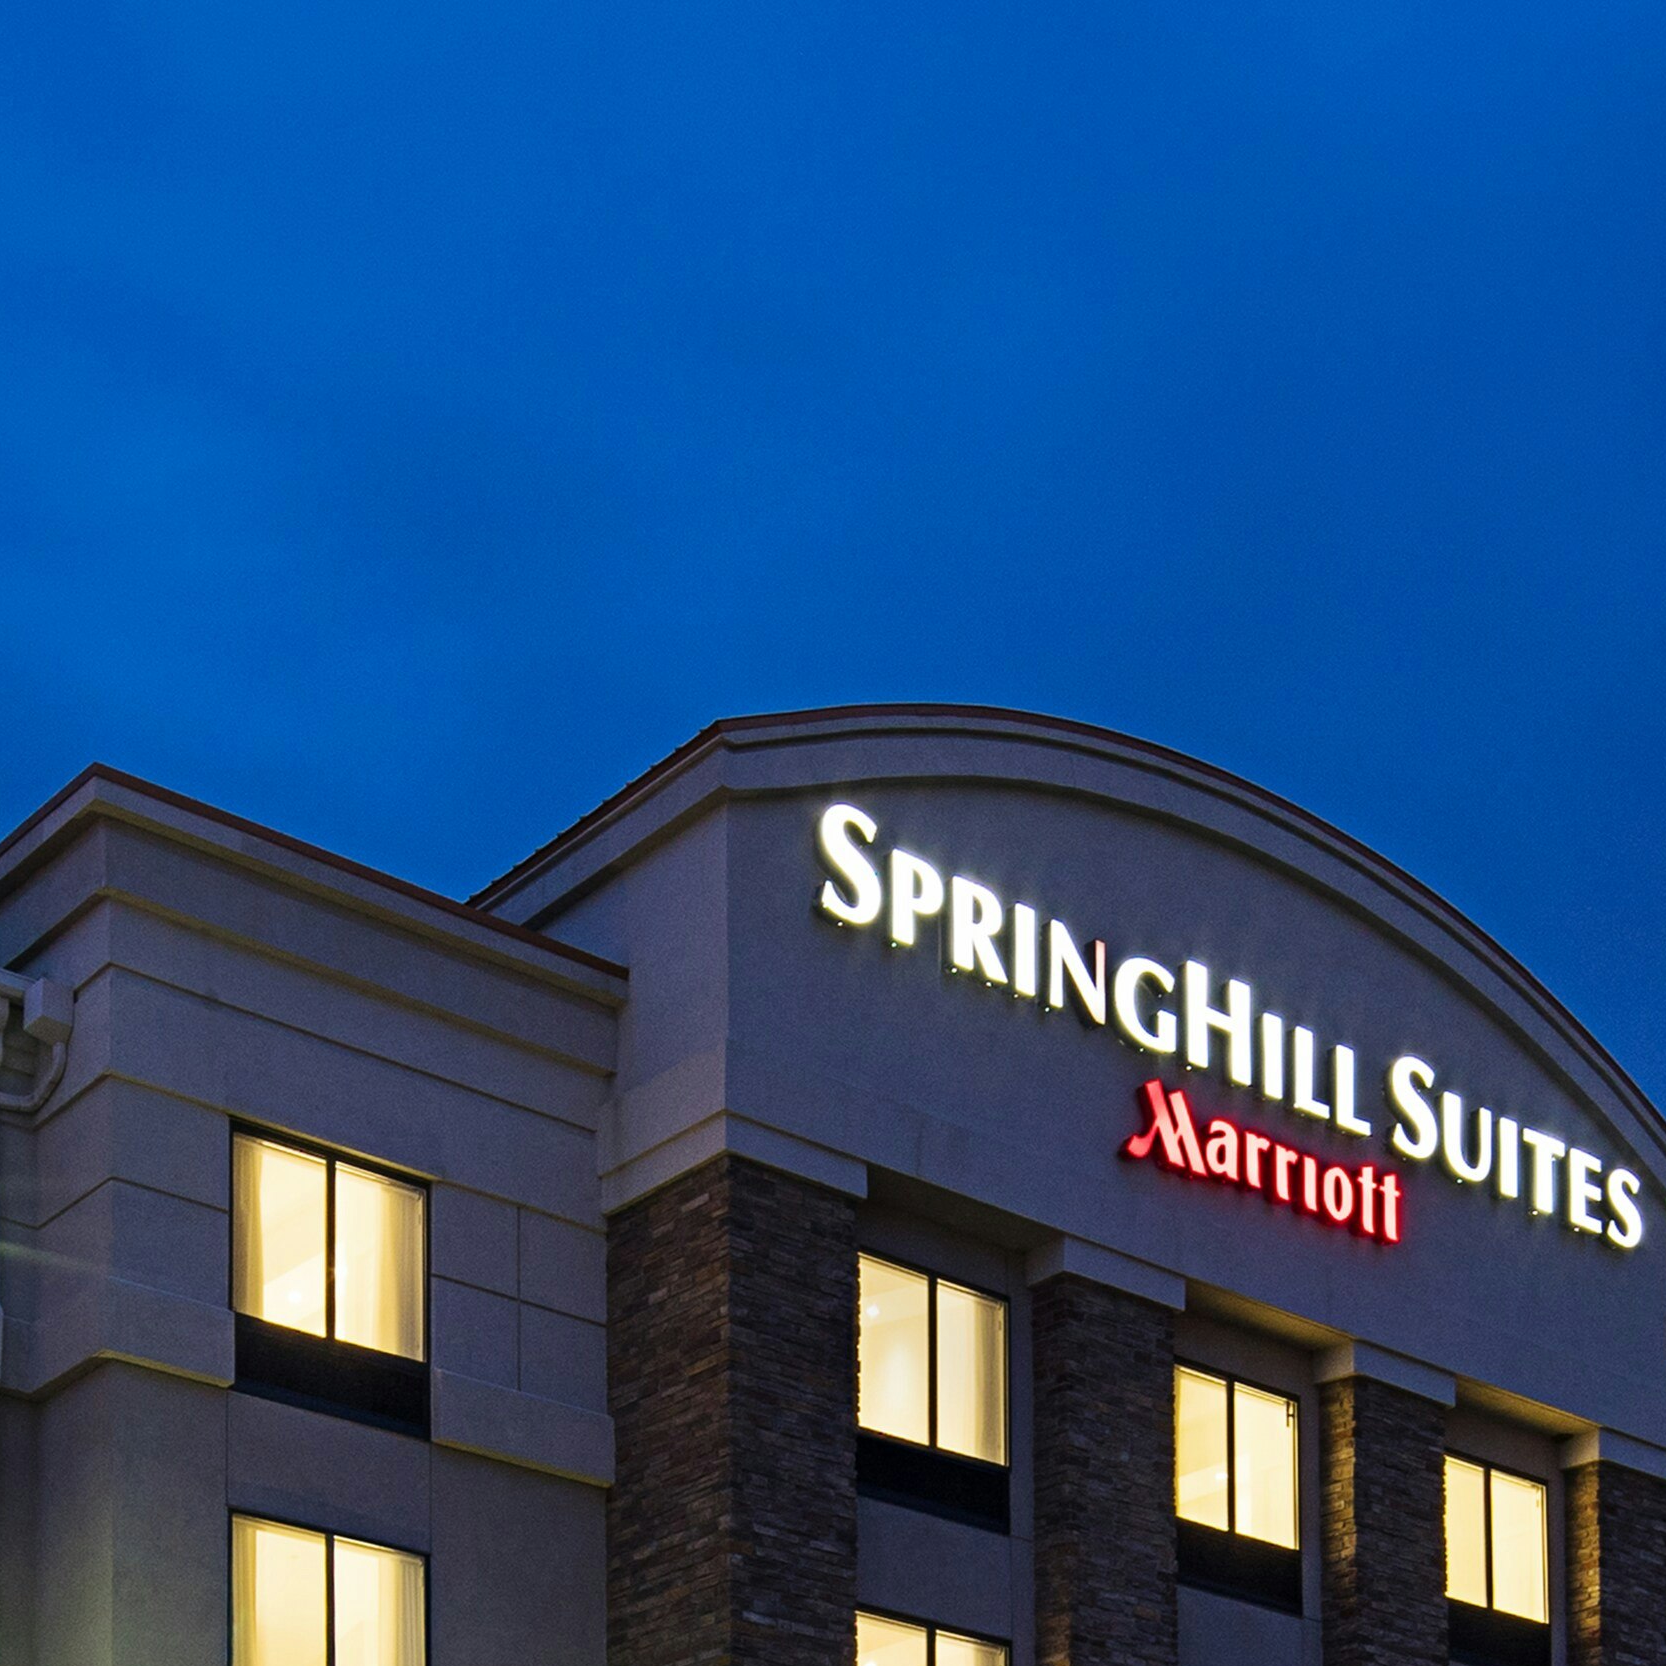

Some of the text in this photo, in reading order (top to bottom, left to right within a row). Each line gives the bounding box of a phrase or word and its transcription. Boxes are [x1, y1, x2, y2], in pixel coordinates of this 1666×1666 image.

[820, 802, 1643, 1249] SPRINGHILL SUITES
[1127, 1078, 1401, 1242] Marriott
